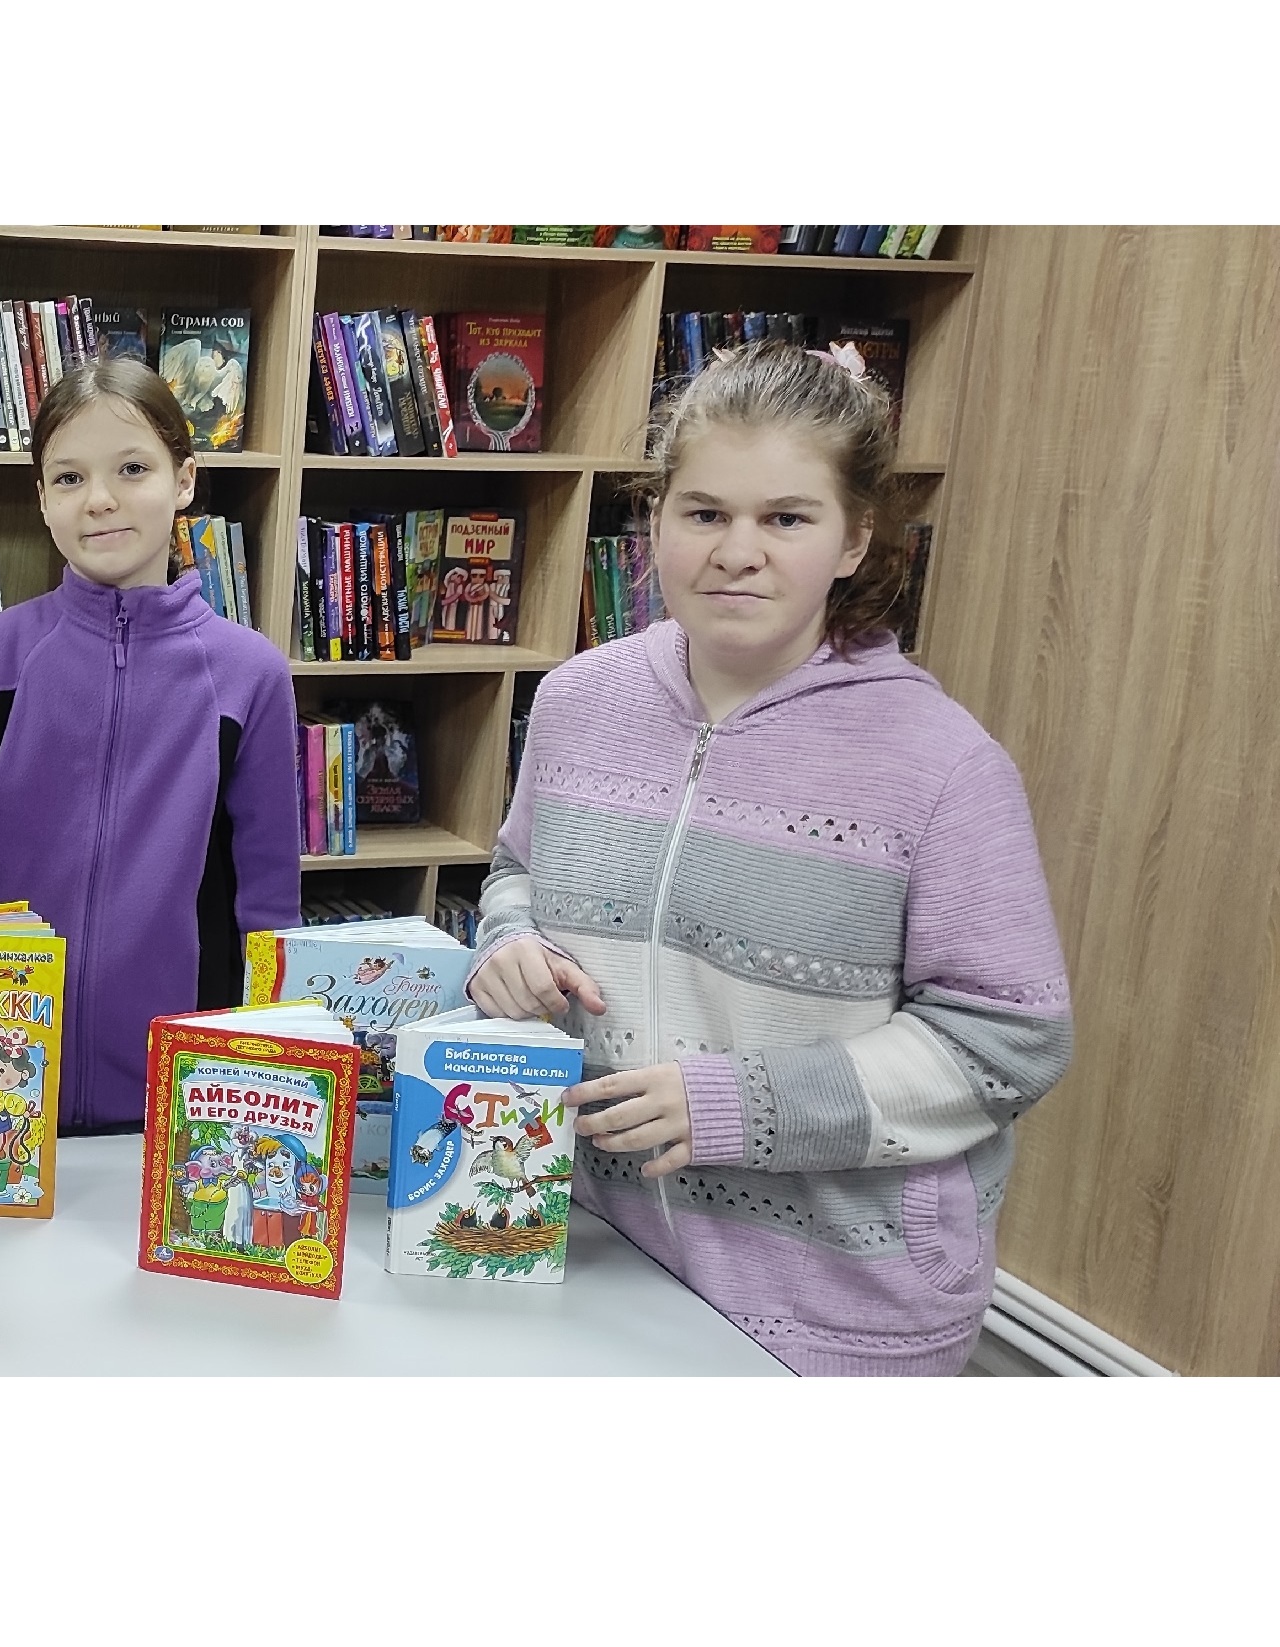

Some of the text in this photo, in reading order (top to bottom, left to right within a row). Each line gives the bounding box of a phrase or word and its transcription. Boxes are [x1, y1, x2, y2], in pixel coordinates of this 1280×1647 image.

[451, 523, 510, 536] ПОДЗЕМНЫЙ
[464, 540, 496, 554] МИР
[342, 529, 354, 621] СМЕРТНЫЕ МАШИНЫ
[358, 530, 369, 621] ЗОЛОТО ХИЩНИКОВ
[377, 530, 390, 621] АДСКИЕ КОНСТРУКЦИИ
[445, 1048, 527, 1064] Библиотека
[197, 1066, 308, 1088] КОРНЕЙ ЧУКОВСКИЙ
[445, 1062, 568, 1079] начальной школы
[188, 1084, 319, 1118] АЙБОЛИТ
[190, 1107, 313, 1133] И ЕГО ДРУЗЬЯ
[408, 1139, 454, 1202] БОРИС ЗАХОДЕР
